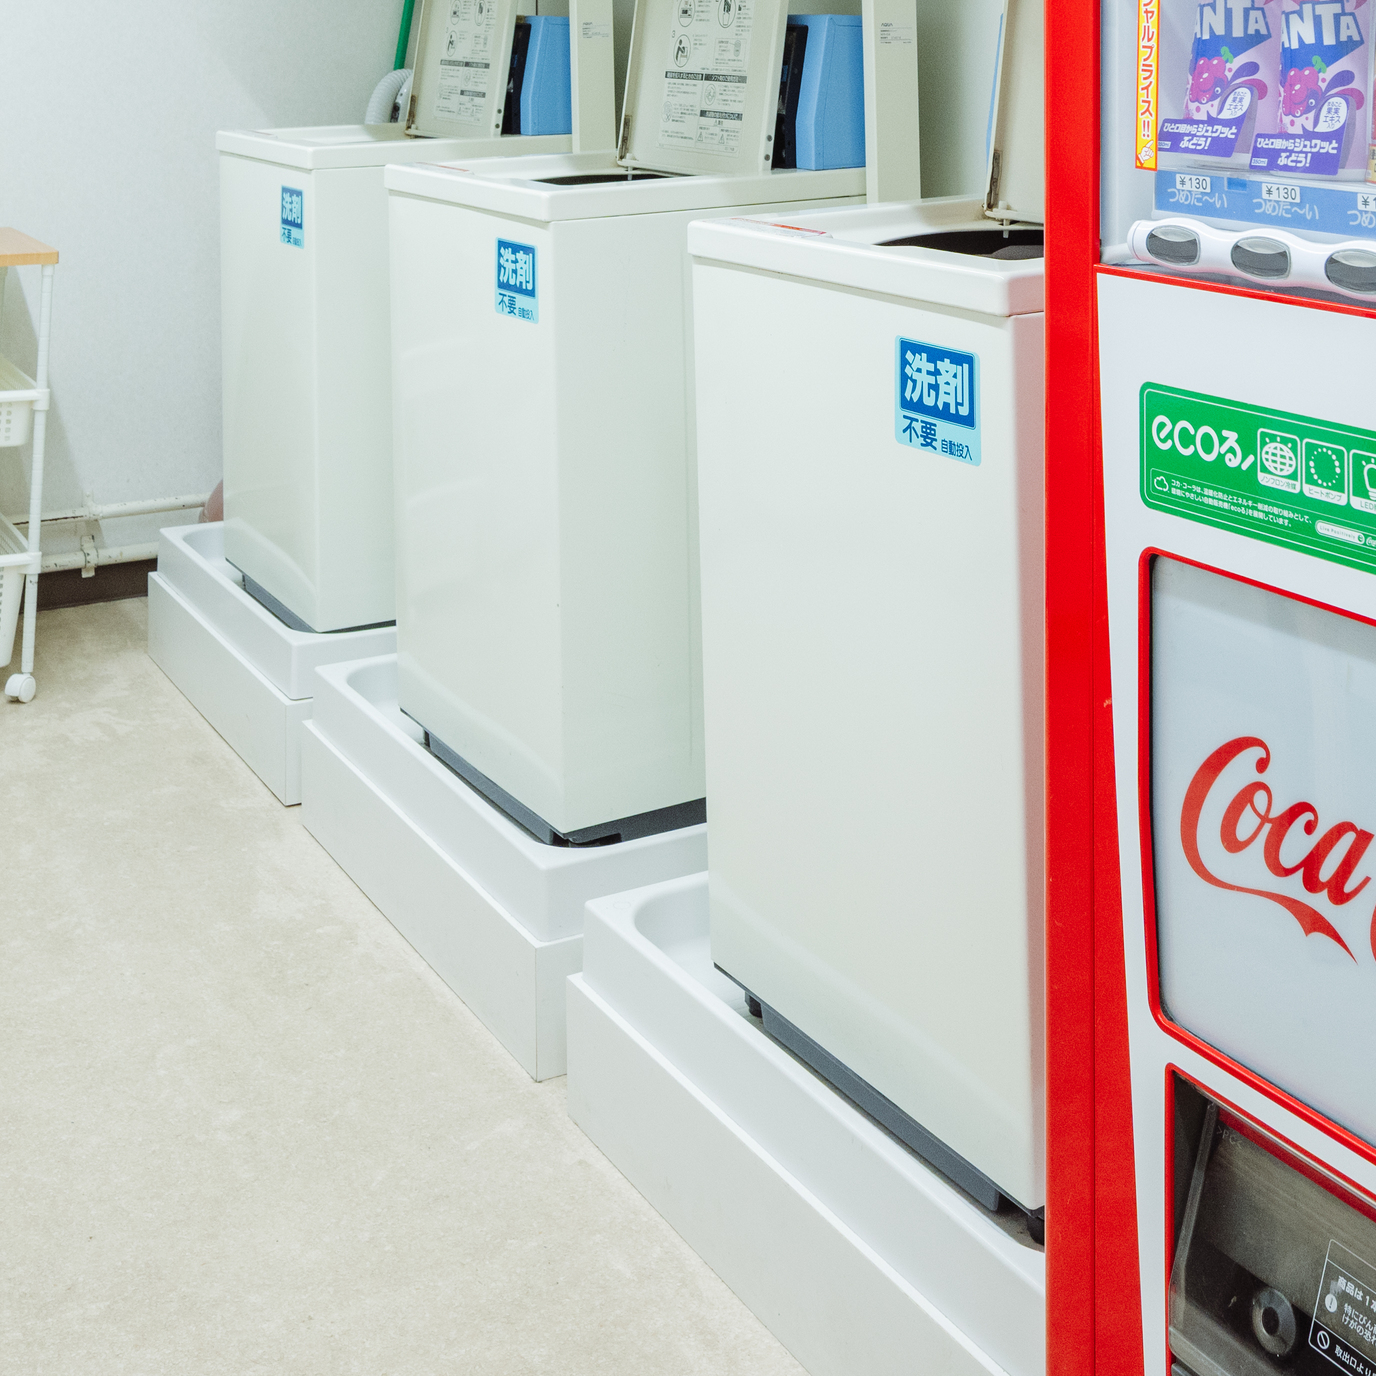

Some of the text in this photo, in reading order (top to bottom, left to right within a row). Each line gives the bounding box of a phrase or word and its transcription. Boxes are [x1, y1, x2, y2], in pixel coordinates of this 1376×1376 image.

[1179, 176, 1208, 191] ¥130
[282, 191, 302, 225] 洗剤
[498, 246, 533, 291] 洗剤
[497, 292, 517, 316] 不要
[904, 349, 970, 417] 洗剤
[902, 414, 973, 462] 不要 自動投入
[1151, 413, 1244, 470] ecoる
[1260, 475, 1297, 492] ノンフロン冷媒
[1307, 486, 1343, 503] ヒートポンプ
